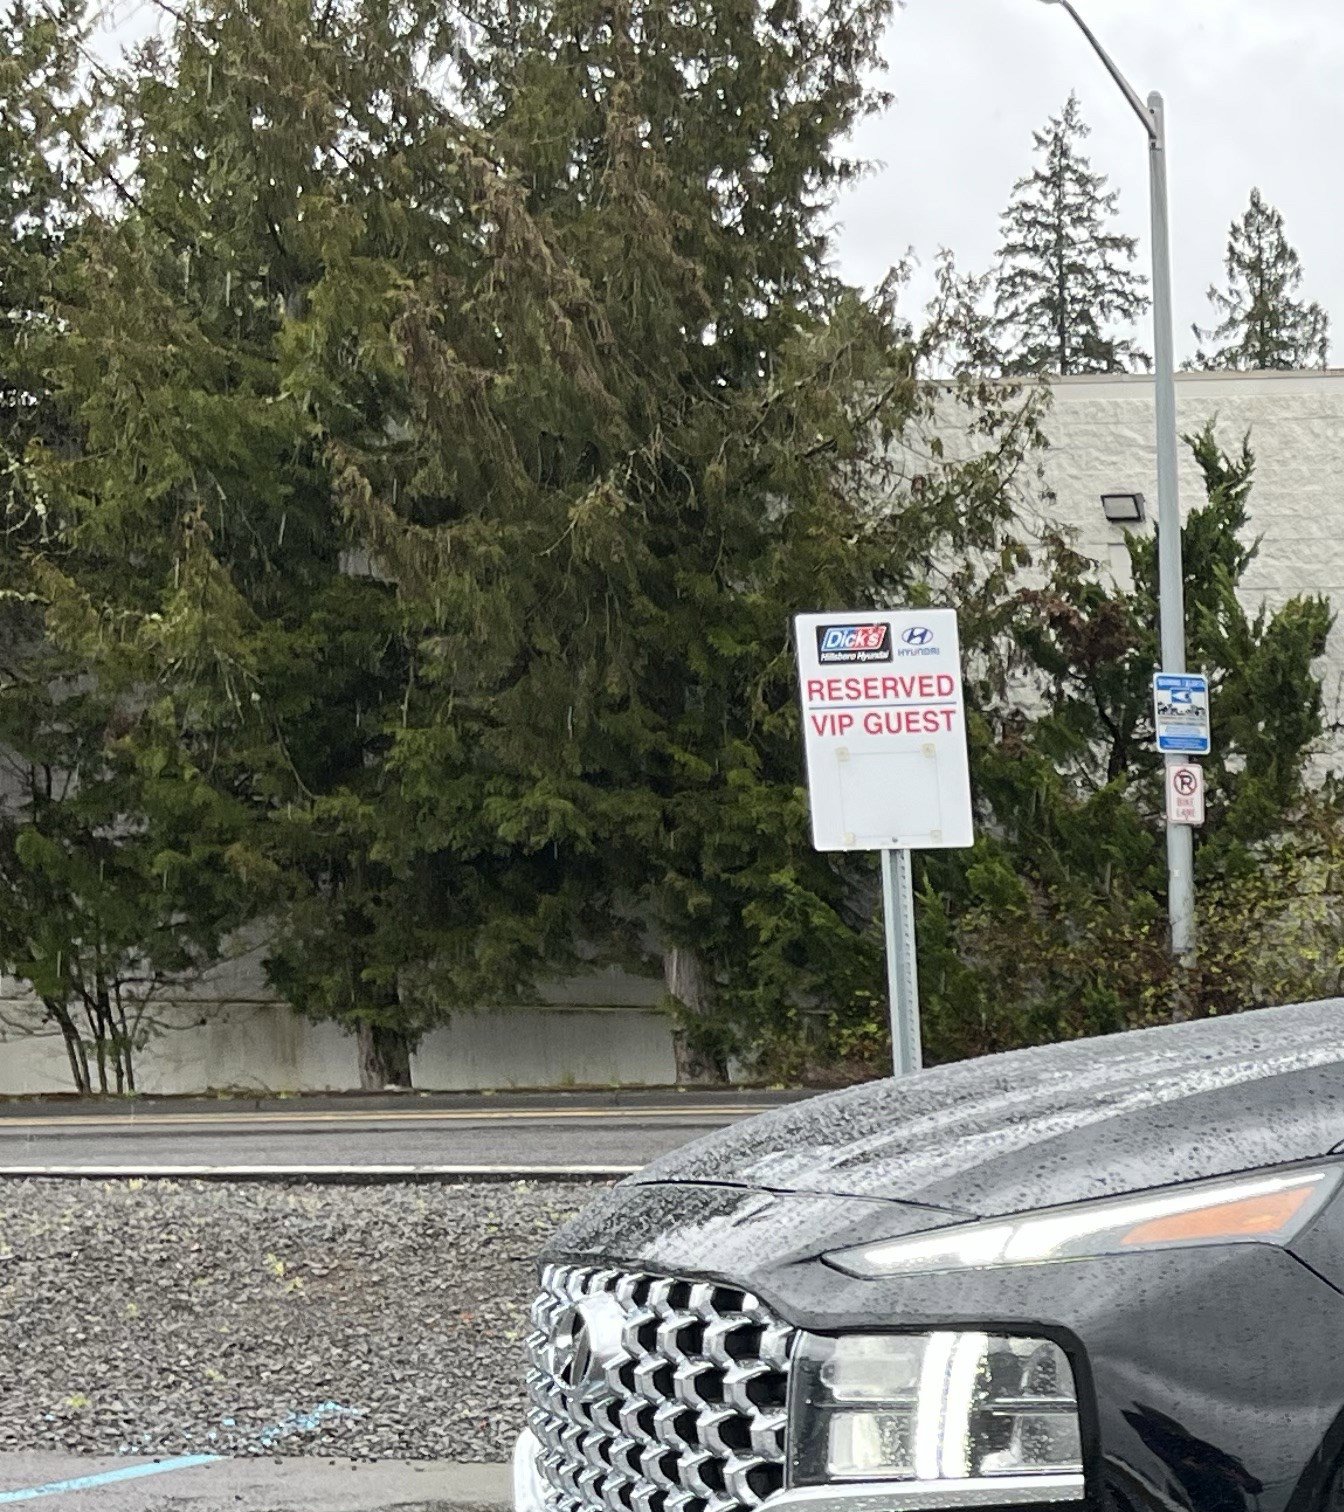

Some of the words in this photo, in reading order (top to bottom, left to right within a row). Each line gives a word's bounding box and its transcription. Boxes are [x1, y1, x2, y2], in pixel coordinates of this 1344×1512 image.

[824, 628, 882, 650] Dick's
[820, 651, 857, 662] Hillsboro
[857, 649, 889, 662] Hyundai
[897, 646, 940, 657] HYUNDAI
[807, 675, 955, 701] RESERVED
[812, 713, 854, 736] VIP
[863, 710, 957, 735] GUEST
